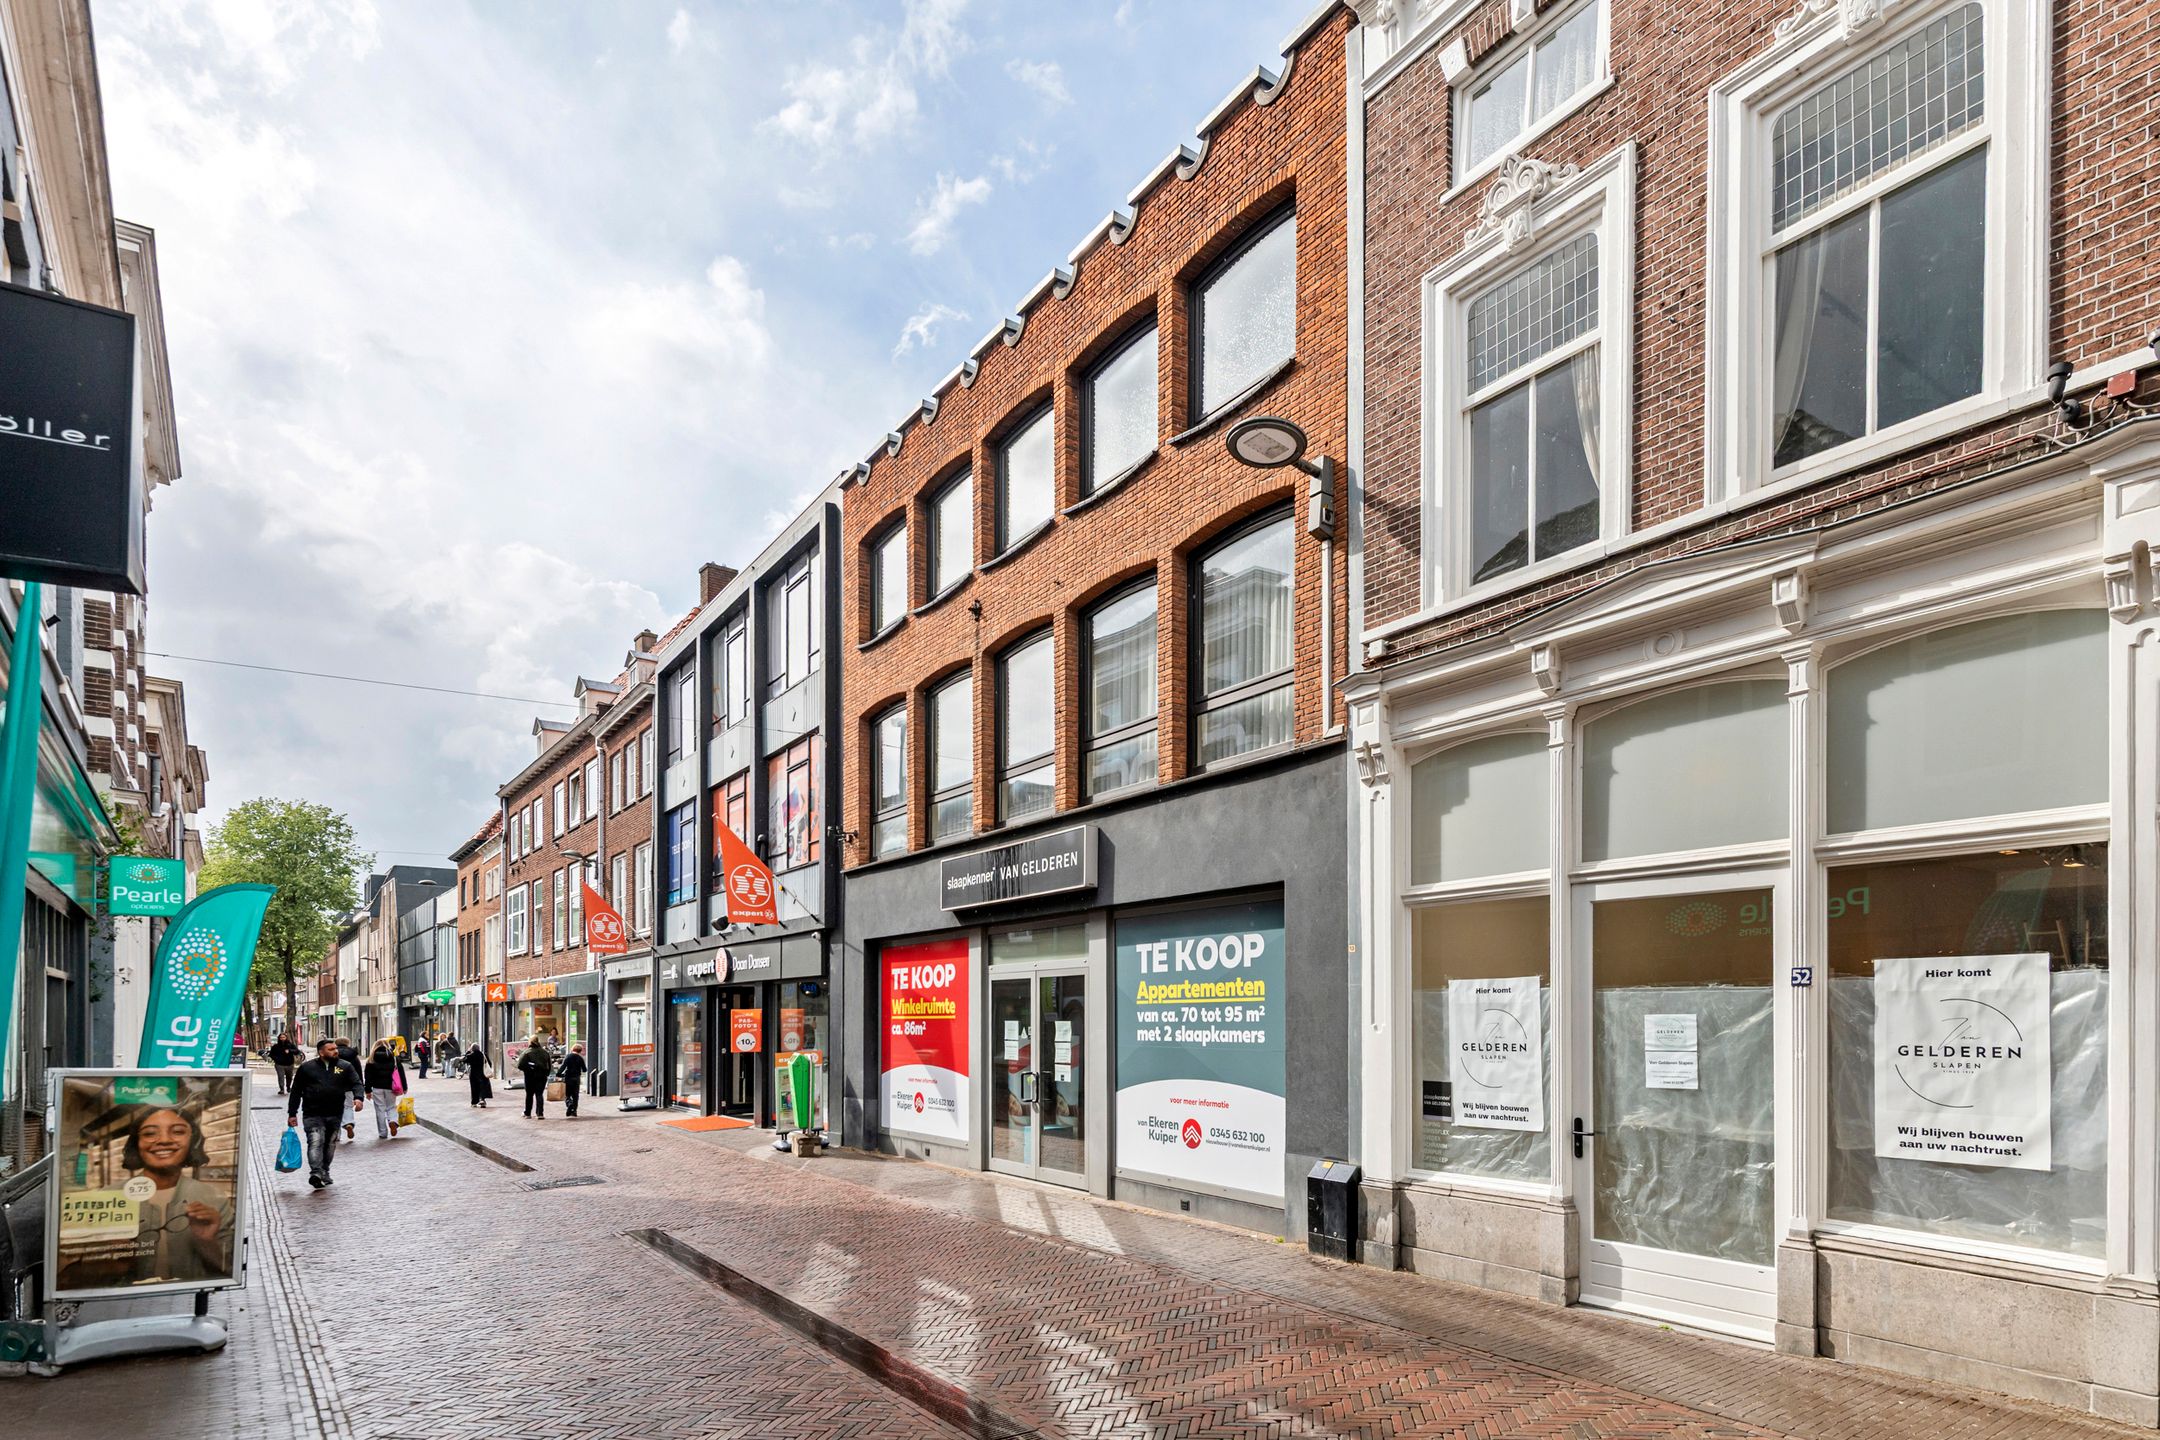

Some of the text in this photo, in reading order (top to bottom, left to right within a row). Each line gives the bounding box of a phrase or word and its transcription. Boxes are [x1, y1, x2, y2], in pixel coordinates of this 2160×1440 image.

[1000, 864, 1019, 880] VAN
[1021, 851, 1078, 876] GELDEREN
[113, 886, 182, 904] Pearle
[1136, 933, 1265, 973] TE KOOP
[687, 959, 714, 977] expert
[1957, 968, 1991, 977] komt
[892, 963, 956, 990] TE KOOP
[1792, 969, 1811, 984] 52
[1136, 977, 1266, 1004] Appartementen
[892, 997, 956, 1015] Winkelruimte
[1137, 1011, 1158, 1022] van
[1161, 1011, 1178, 1022] ca.
[1181, 1007, 1198, 1022] 70
[1201, 1007, 1221, 1022] tot
[1224, 1006, 1243, 1022] 95
[892, 1024, 903, 1035] ca.
[1137, 1025, 1265, 1046] met 2 slaapkamers
[201, 1018, 221, 1068] pticiens
[1462, 1042, 1527, 1052] GELDEREN
[1897, 1045, 2022, 1058] GELDEREN
[947, 1099, 955, 1107] 100
[1198, 1099, 1229, 1109] informatie
[1462, 1102, 1474, 1111] Wij
[1475, 1103, 1499, 1112] blijven
[1148, 1116, 1179, 1130] Ekeren
[1490, 1114, 1529, 1122] nachtrust.
[1148, 1129, 1178, 1144] Kuiper
[1210, 1127, 1265, 1143] 0345 632 100
[1898, 1126, 2023, 1142] Wij blijven bouwen
[1899, 1141, 2022, 1156] aan uw nachtrust.
